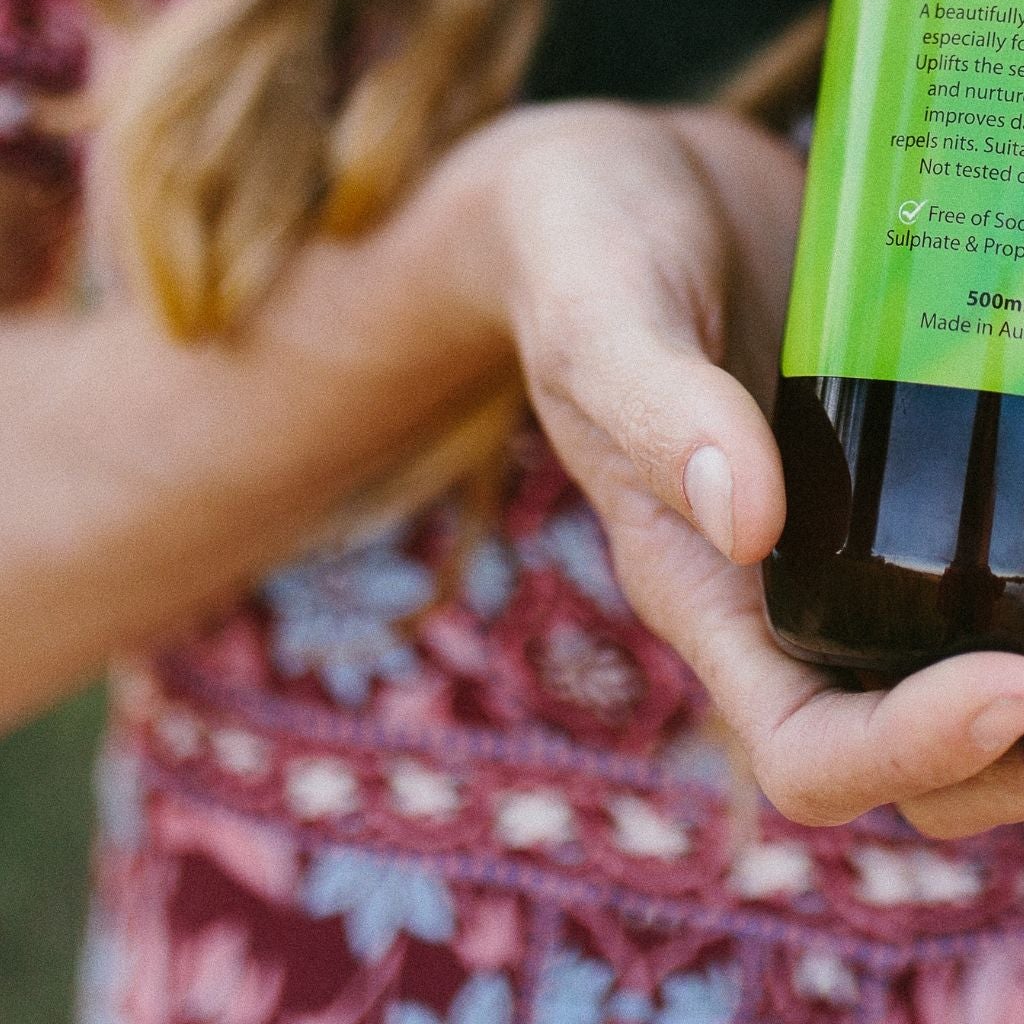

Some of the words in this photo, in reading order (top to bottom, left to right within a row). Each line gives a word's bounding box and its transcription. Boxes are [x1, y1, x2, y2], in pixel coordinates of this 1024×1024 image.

[920, 4, 930, 18] A
[922, 30, 1007, 52] especially
[916, 54, 969, 73] Uplifts
[974, 57, 1004, 75] the
[927, 81, 960, 98] and
[924, 106, 1005, 128] improves
[890, 132, 938, 151] repels
[943, 134, 978, 152] nits.
[919, 158, 951, 175] Not
[955, 160, 1012, 182] tested
[928, 206, 966, 224] Free
[970, 210, 992, 226] of
[885, 229, 961, 251] Sulphate
[965, 236, 978, 253] &
[920, 312, 971, 334] Made
[977, 318, 993, 336] in
